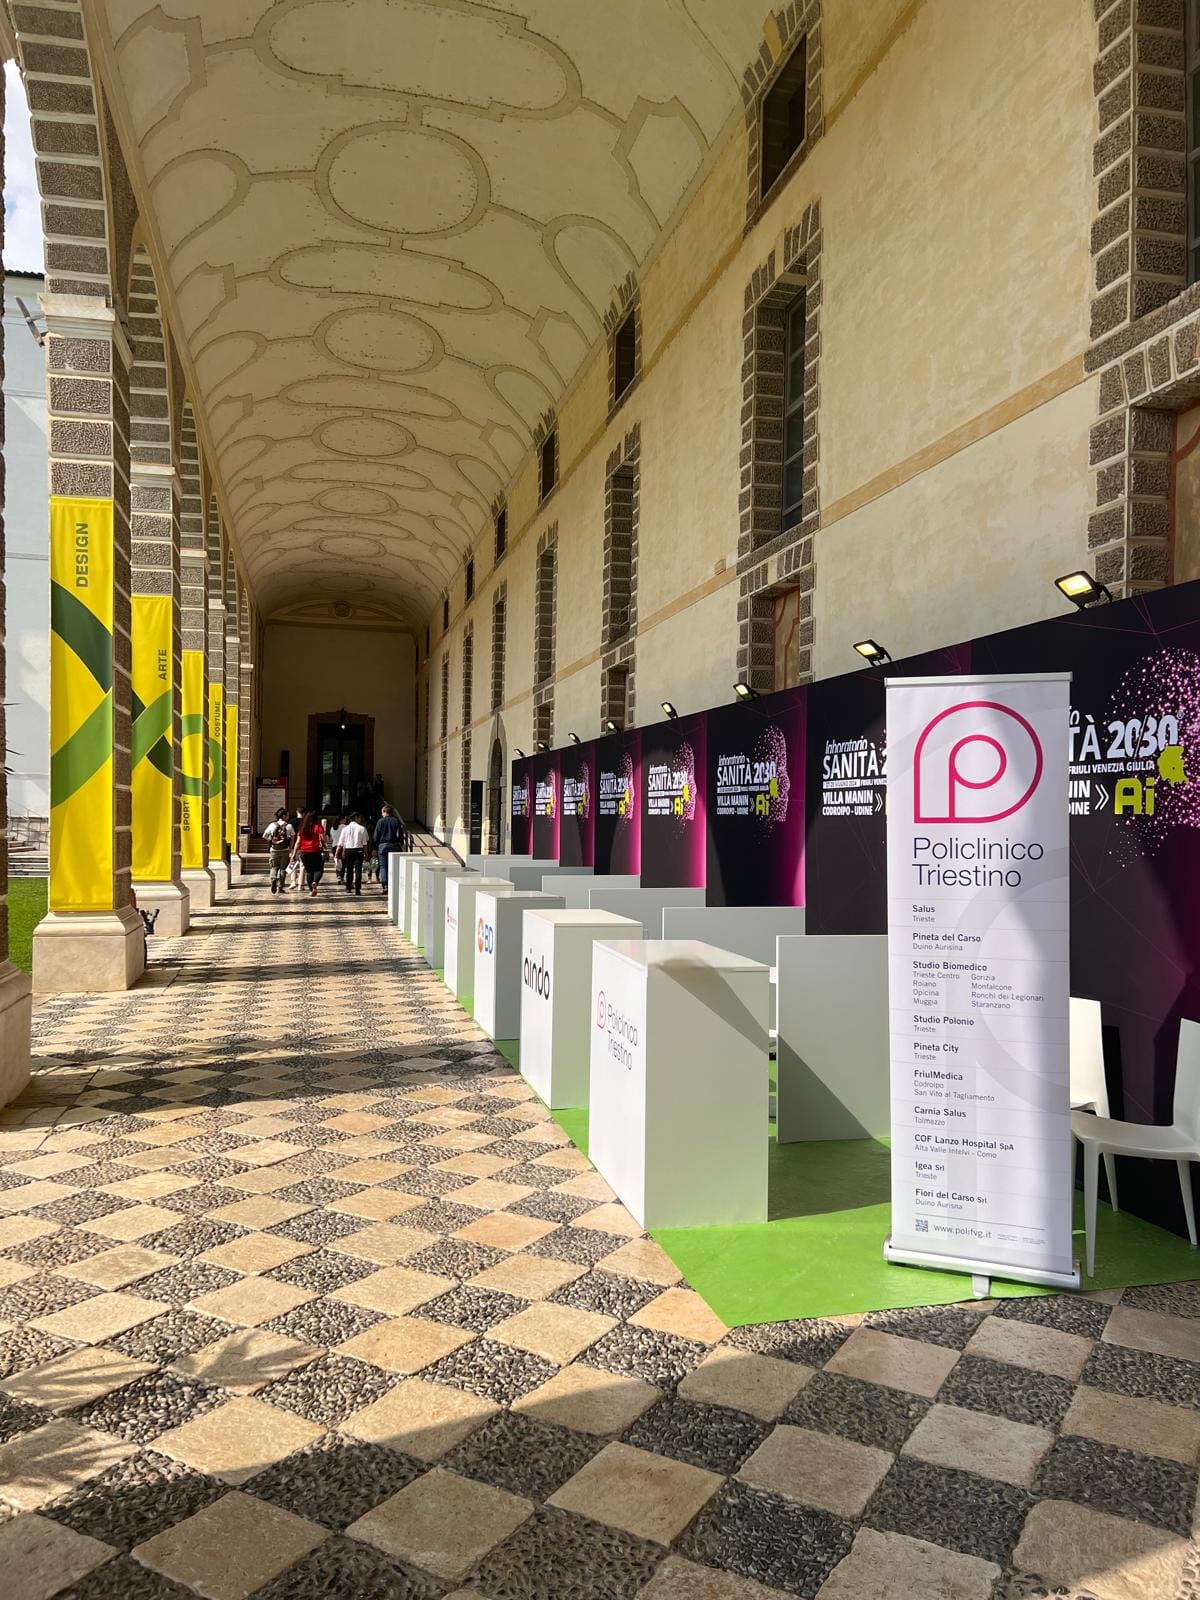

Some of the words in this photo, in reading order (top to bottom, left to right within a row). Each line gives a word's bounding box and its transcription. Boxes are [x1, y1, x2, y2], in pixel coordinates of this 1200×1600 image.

[76, 523, 89, 588] DESIGN
[158, 649, 167, 680] ARTE
[1106, 714, 1179, 760] 2030
[825, 736, 868, 755] laboratorio
[822, 742, 879, 780] SANITÀ
[1092, 762, 1124, 773] VENEZIA
[1126, 760, 1155, 771] GIULIA
[717, 758, 752, 786] SANITÀ
[753, 761, 776, 784] 2030
[648, 768, 672, 791] SANITÀ
[822, 791, 844, 804] VILLA
[844, 790, 873, 804] MANIN
[1114, 777, 1155, 815] Ai
[822, 806, 850, 816] CODROIPO
[854, 806, 873, 816] UDINE
[914, 837, 1044, 860] Policlinico
[912, 864, 1022, 887] Triestino
[912, 904, 936, 913] Salus
[484, 924, 494, 954] BD
[912, 932, 940, 941] Pineta
[942, 933, 955, 942] del
[958, 934, 982, 943] Carso
[934, 944, 964, 952] Aurisina
[912, 960, 941, 970] Studio
[942, 962, 988, 972] Biomedico
[524, 948, 550, 1000] aindo
[936, 972, 960, 980] Centro
[971, 974, 996, 982] Gorizia
[971, 982, 1012, 991] Monfalcone
[912, 988, 940, 998] Opicina
[971, 992, 996, 1000] Ronchi
[1011, 993, 1045, 1002] Legionari
[912, 998, 938, 1007] Muggia
[971, 1001, 1011, 1010] Staranzano
[608, 1002, 638, 1047] Policlinico
[914, 1014, 940, 1024] Studio
[944, 1016, 974, 1026] Polonio
[914, 1025, 936, 1033] Trieste
[607, 1029, 632, 1070] Triestino
[914, 1042, 940, 1052] Pineta
[942, 1044, 960, 1054] City
[914, 1052, 936, 1061] Trieste
[914, 1070, 964, 1081] FriulMedica
[914, 1080, 944, 1089] Codroipo
[914, 1089, 928, 1097] San
[930, 1090, 943, 1098] Vito
[953, 1092, 995, 1102] Tagliamento
[914, 1106, 941, 1116] Carnia
[944, 1108, 967, 1118] Salus
[914, 1116, 946, 1126] Tolmezzo
[914, 1134, 932, 1142] COF
[935, 1136, 960, 1146] Lanzo
[962, 1138, 997, 1150] Hospital
[1000, 1143, 1014, 1152] SpA
[914, 1144, 928, 1152] Alta
[930, 1145, 947, 1154] Valle
[948, 1147, 970, 1156] Intelvi
[976, 1150, 998, 1159] Como
[915, 1161, 933, 1172] Igea
[916, 1171, 938, 1180] Trieste
[915, 1188, 934, 1198] Fiori
[936, 1191, 949, 1200] del
[952, 1192, 975, 1203] Carso
[977, 1196, 987, 1204] Srl
[915, 1199, 936, 1208] Duino
[934, 1224, 992, 1240] www.polifvg.it
